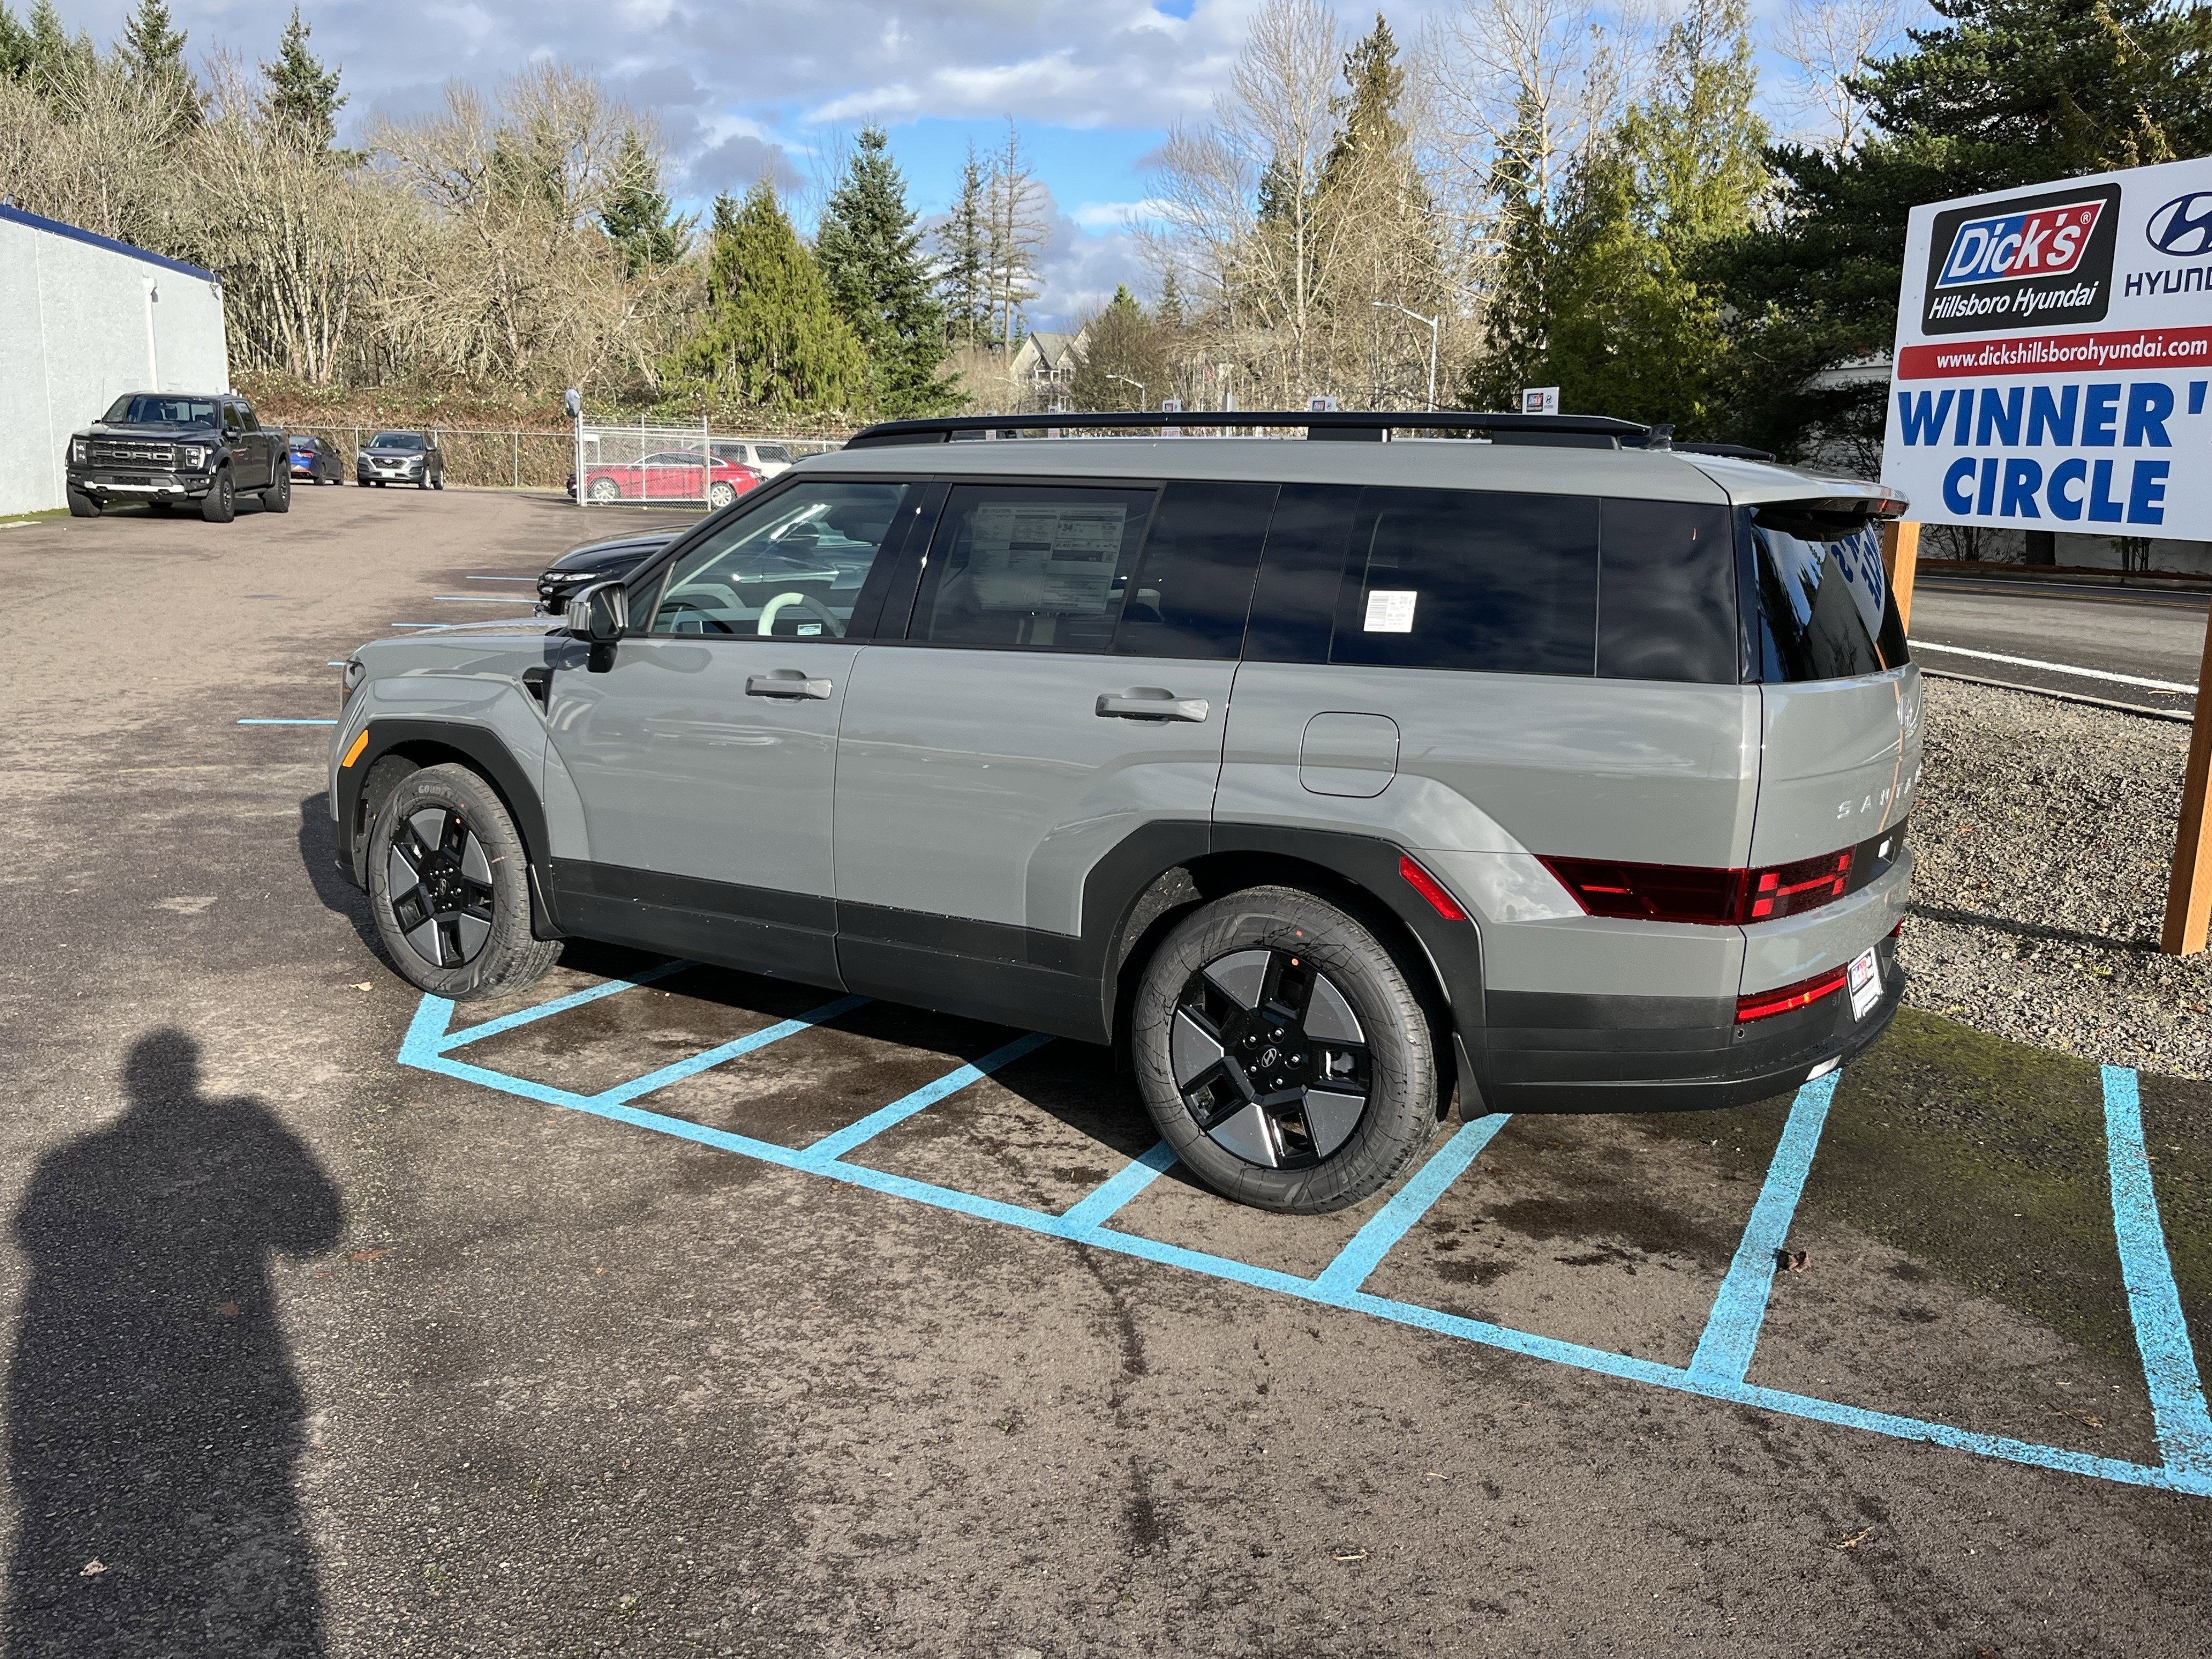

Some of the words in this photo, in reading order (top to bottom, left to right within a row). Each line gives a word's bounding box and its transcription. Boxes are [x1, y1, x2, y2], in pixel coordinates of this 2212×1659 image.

[1928, 291, 2010, 320] Hillsboro
[2012, 281, 2099, 317] Hyundai
[1937, 336, 2208, 369] www.dickshillsborohyundai.com
[1898, 381, 2212, 447] WINNER'
[92, 450, 172, 461] FORD
[1942, 457, 2171, 525] CIRCLE
